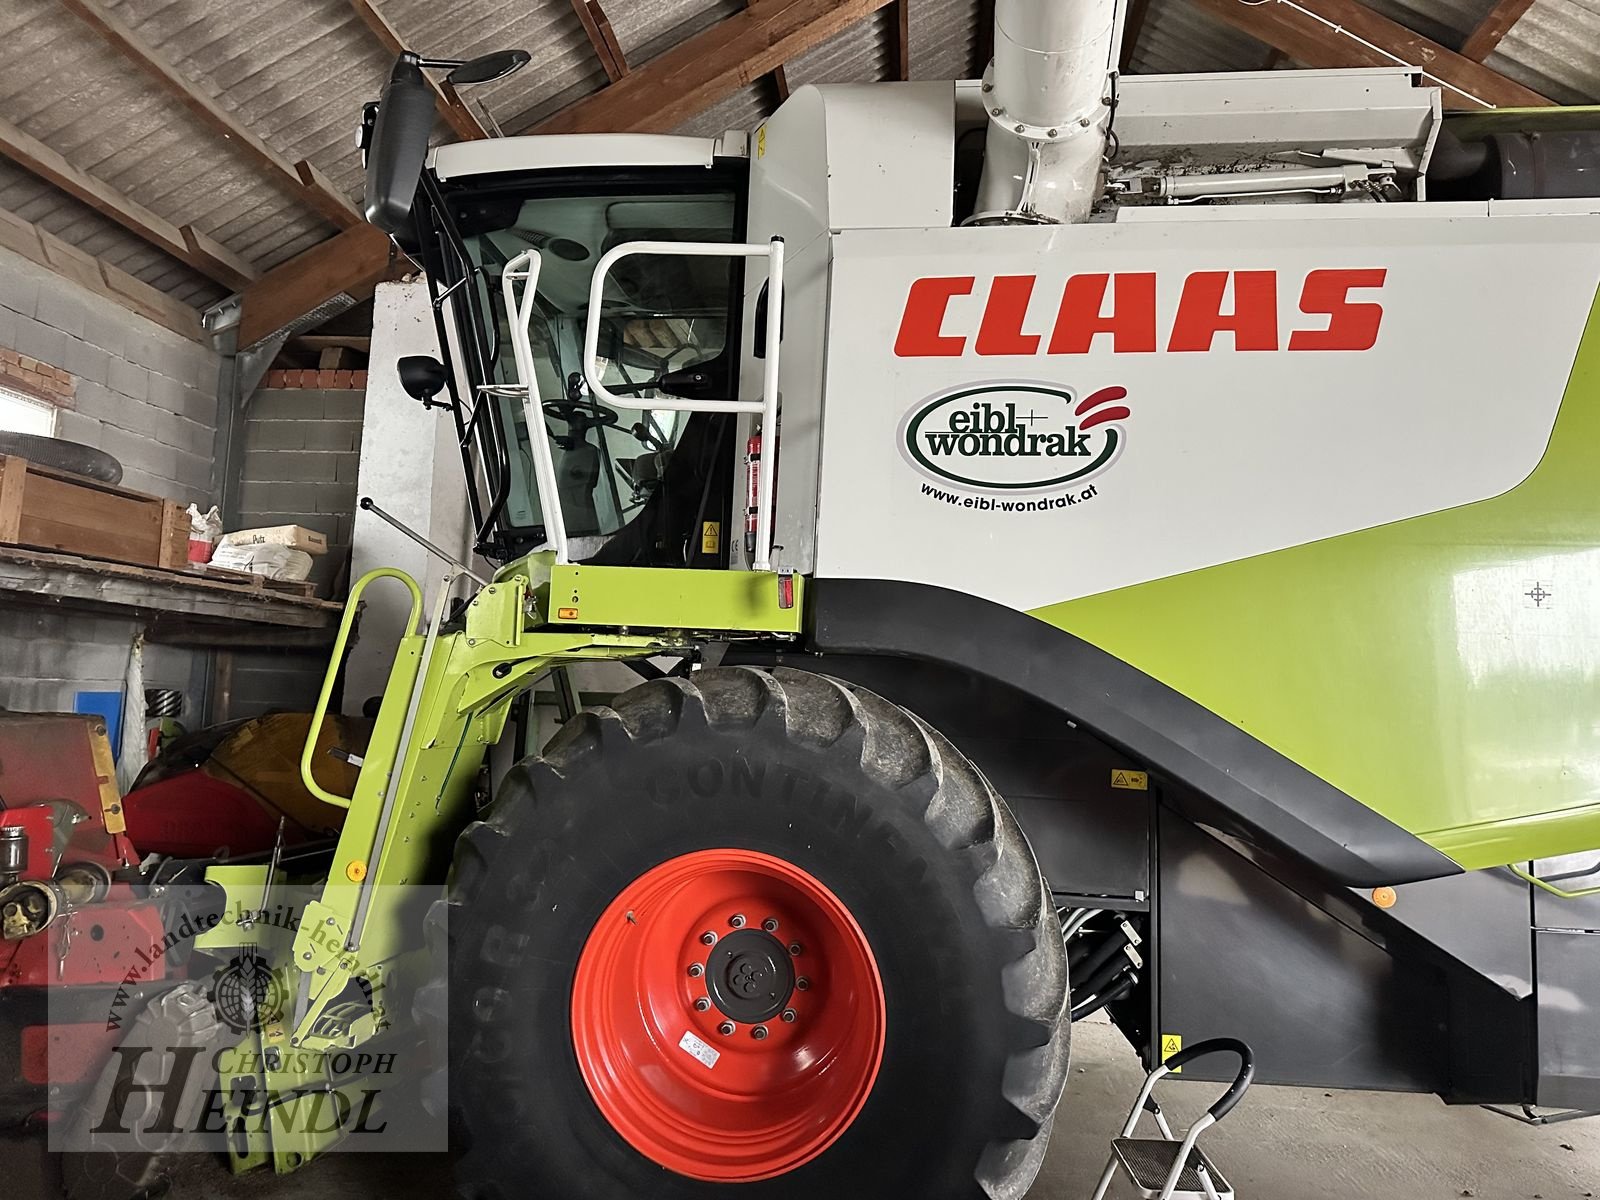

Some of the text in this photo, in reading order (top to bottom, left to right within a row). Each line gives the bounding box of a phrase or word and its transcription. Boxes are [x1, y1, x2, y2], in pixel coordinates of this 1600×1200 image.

[894, 268, 1388, 357] CLAAS
[925, 424, 1091, 456] wondrak
[920, 482, 1098, 512] www.eibl-wondrak.at
